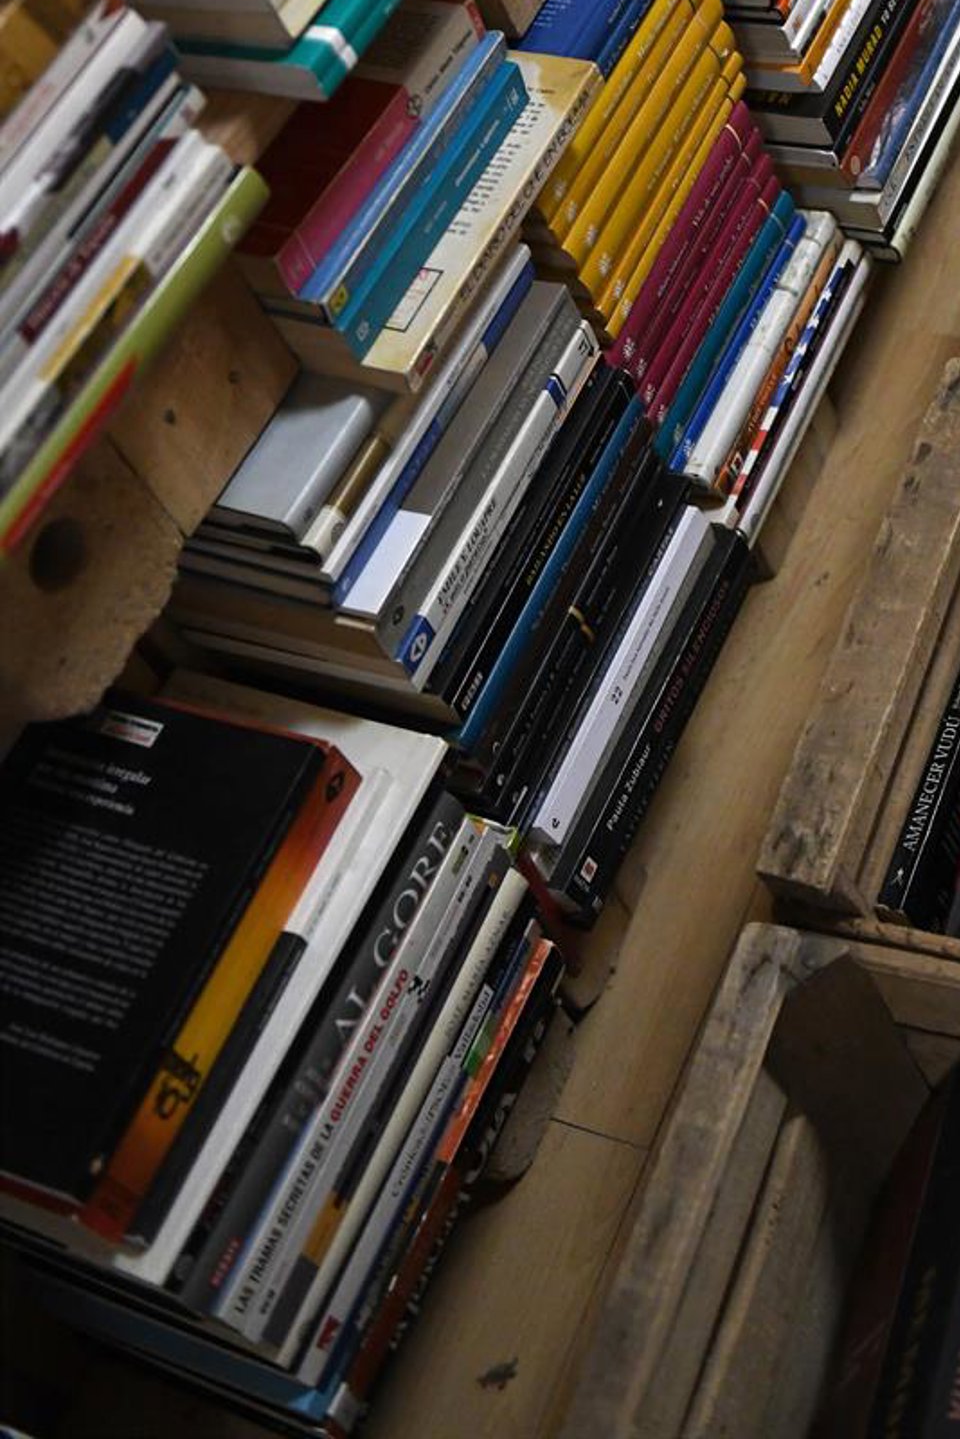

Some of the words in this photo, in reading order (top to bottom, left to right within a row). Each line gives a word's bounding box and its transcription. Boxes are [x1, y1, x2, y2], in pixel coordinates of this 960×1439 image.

[834, 65, 859, 118] NADIA
[854, 26, 884, 74] MURAD
[607, 797, 630, 832] Paula
[624, 744, 653, 796] Zubiaur
[902, 759, 949, 854] AMANECER
[373, 821, 457, 969] GORE
[235, 1284, 255, 1316] LAS
[248, 1235, 284, 1285] TRAMAS
[278, 1158, 317, 1234] SECRETAS
[311, 1140, 328, 1162] DE
[320, 1120, 335, 1142] LA
[329, 1056, 369, 1123] GUERRA
[363, 1023, 386, 1057] DEL
[380, 969, 409, 1022] GOLFO
